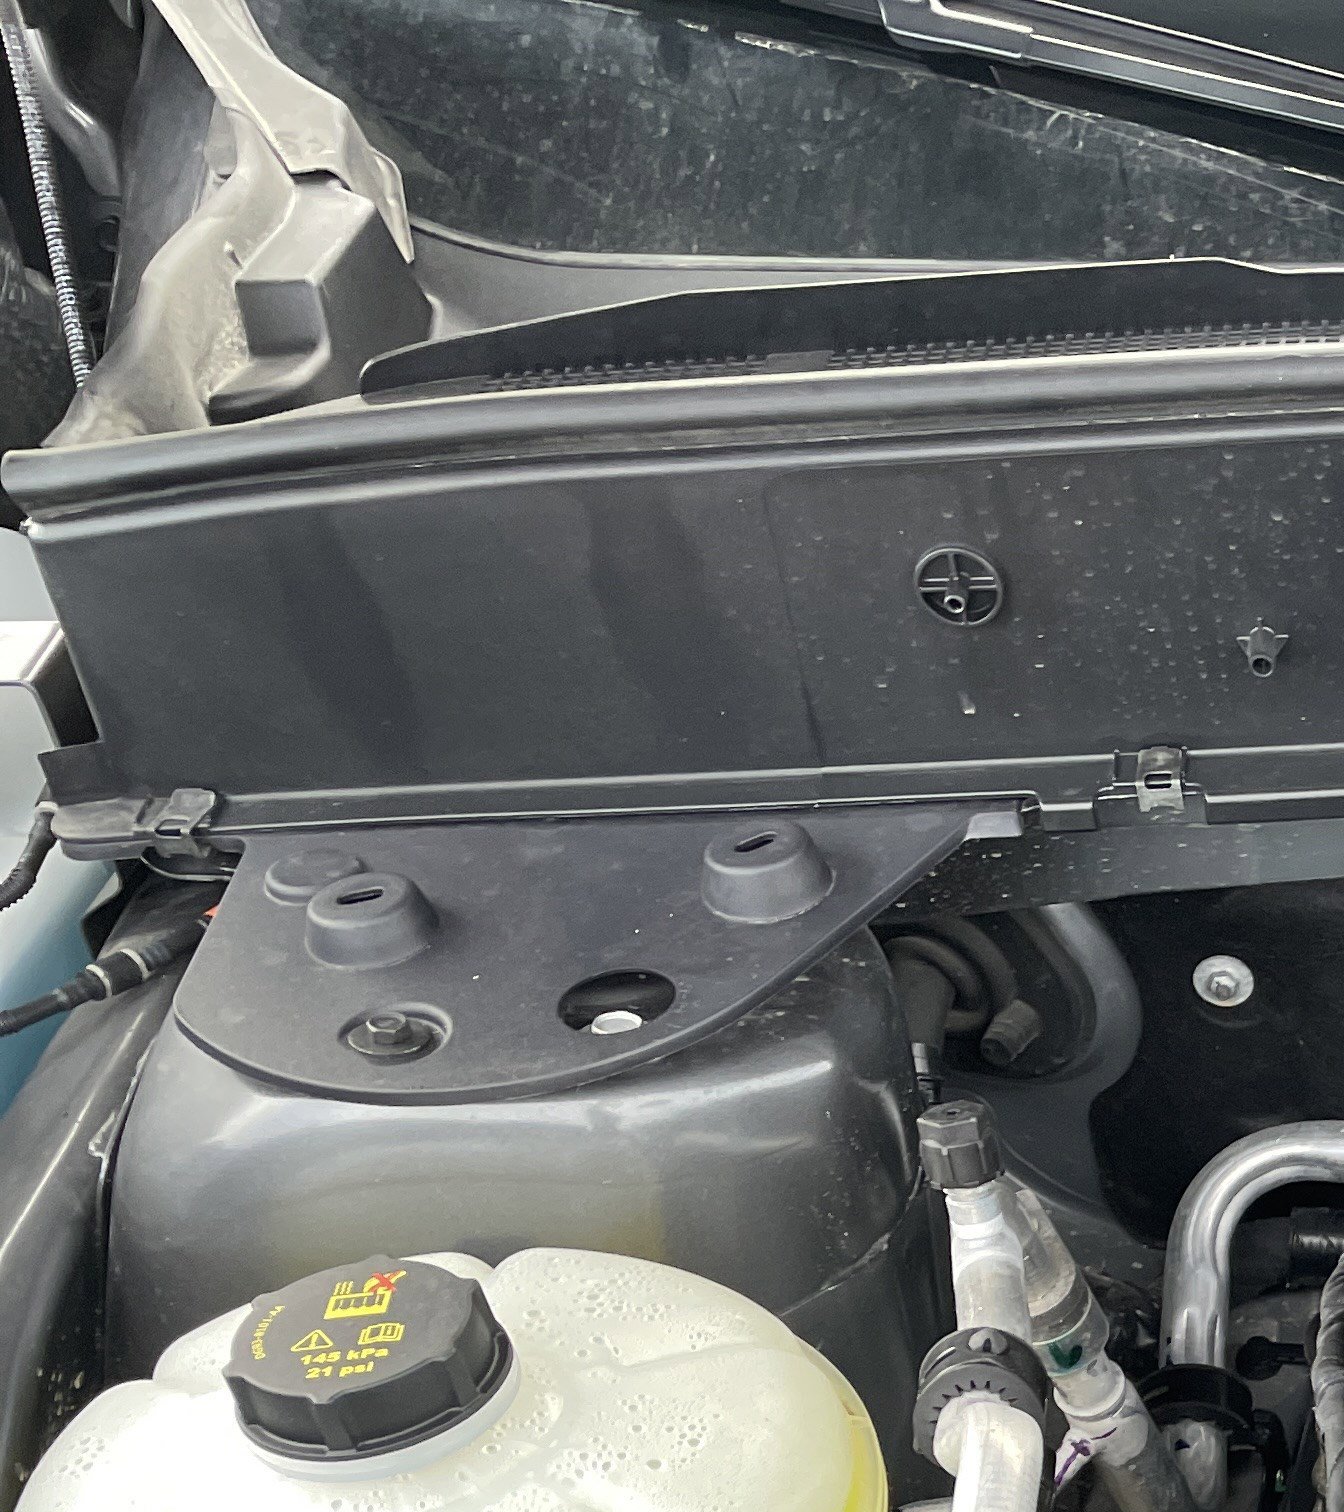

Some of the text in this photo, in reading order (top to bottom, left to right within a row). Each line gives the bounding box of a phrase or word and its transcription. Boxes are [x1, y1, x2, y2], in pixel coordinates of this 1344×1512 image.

[299, 1346, 390, 1366] 145 kPa
[305, 1362, 375, 1380] 21 psi
